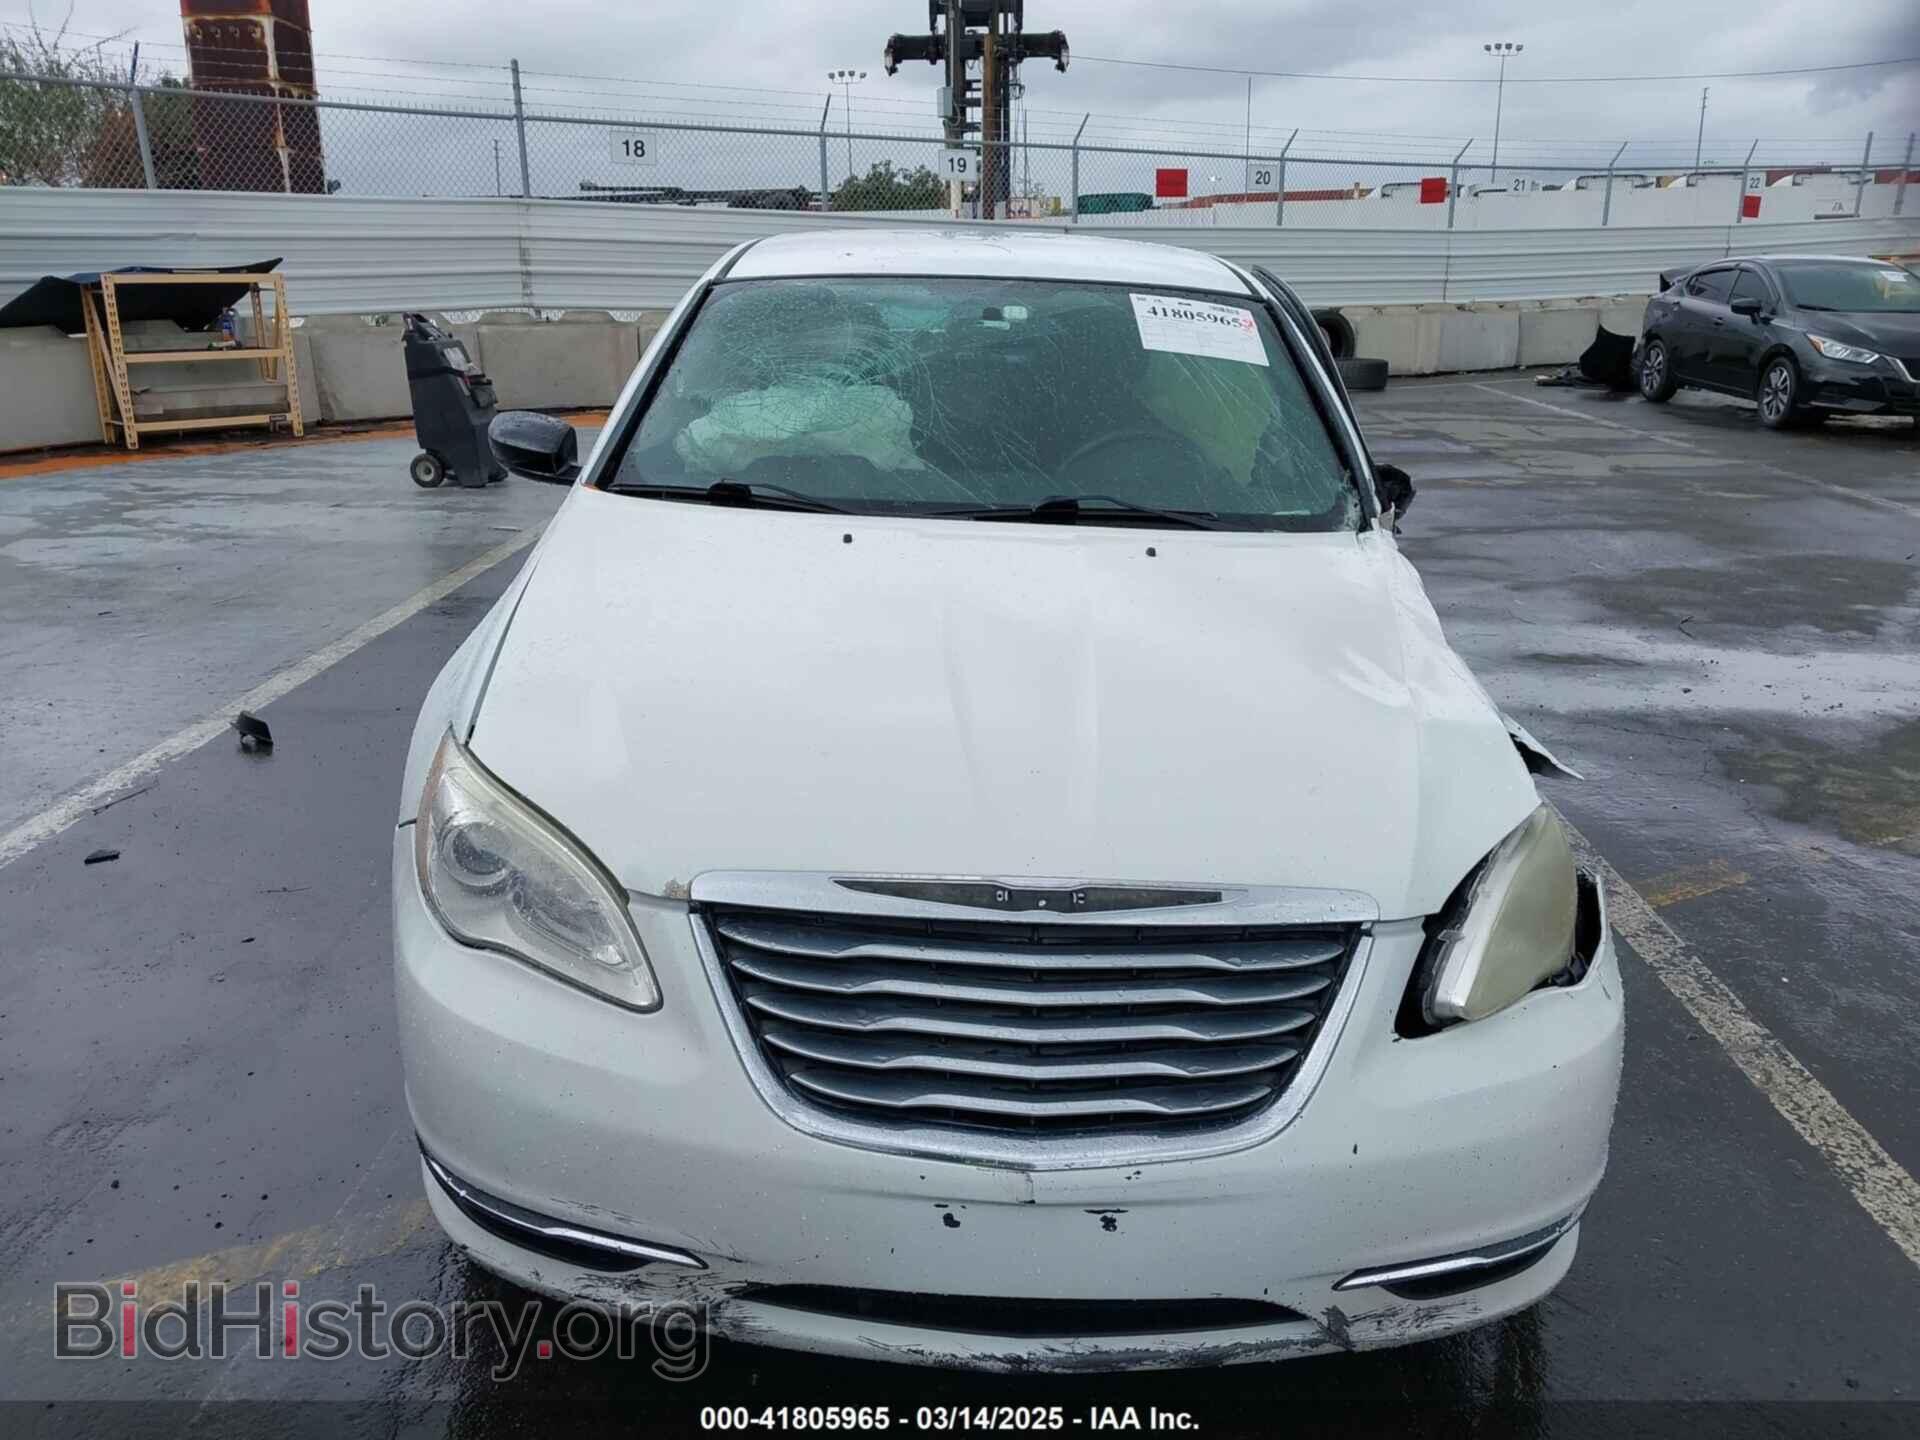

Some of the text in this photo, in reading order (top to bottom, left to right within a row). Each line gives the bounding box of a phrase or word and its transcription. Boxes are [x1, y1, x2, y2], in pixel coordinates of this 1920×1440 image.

[622, 139, 645, 158] 18
[948, 157, 967, 173] 19
[1255, 170, 1271, 185] 20
[1513, 178, 1525, 191] 21
[1749, 177, 1761, 189] 22
